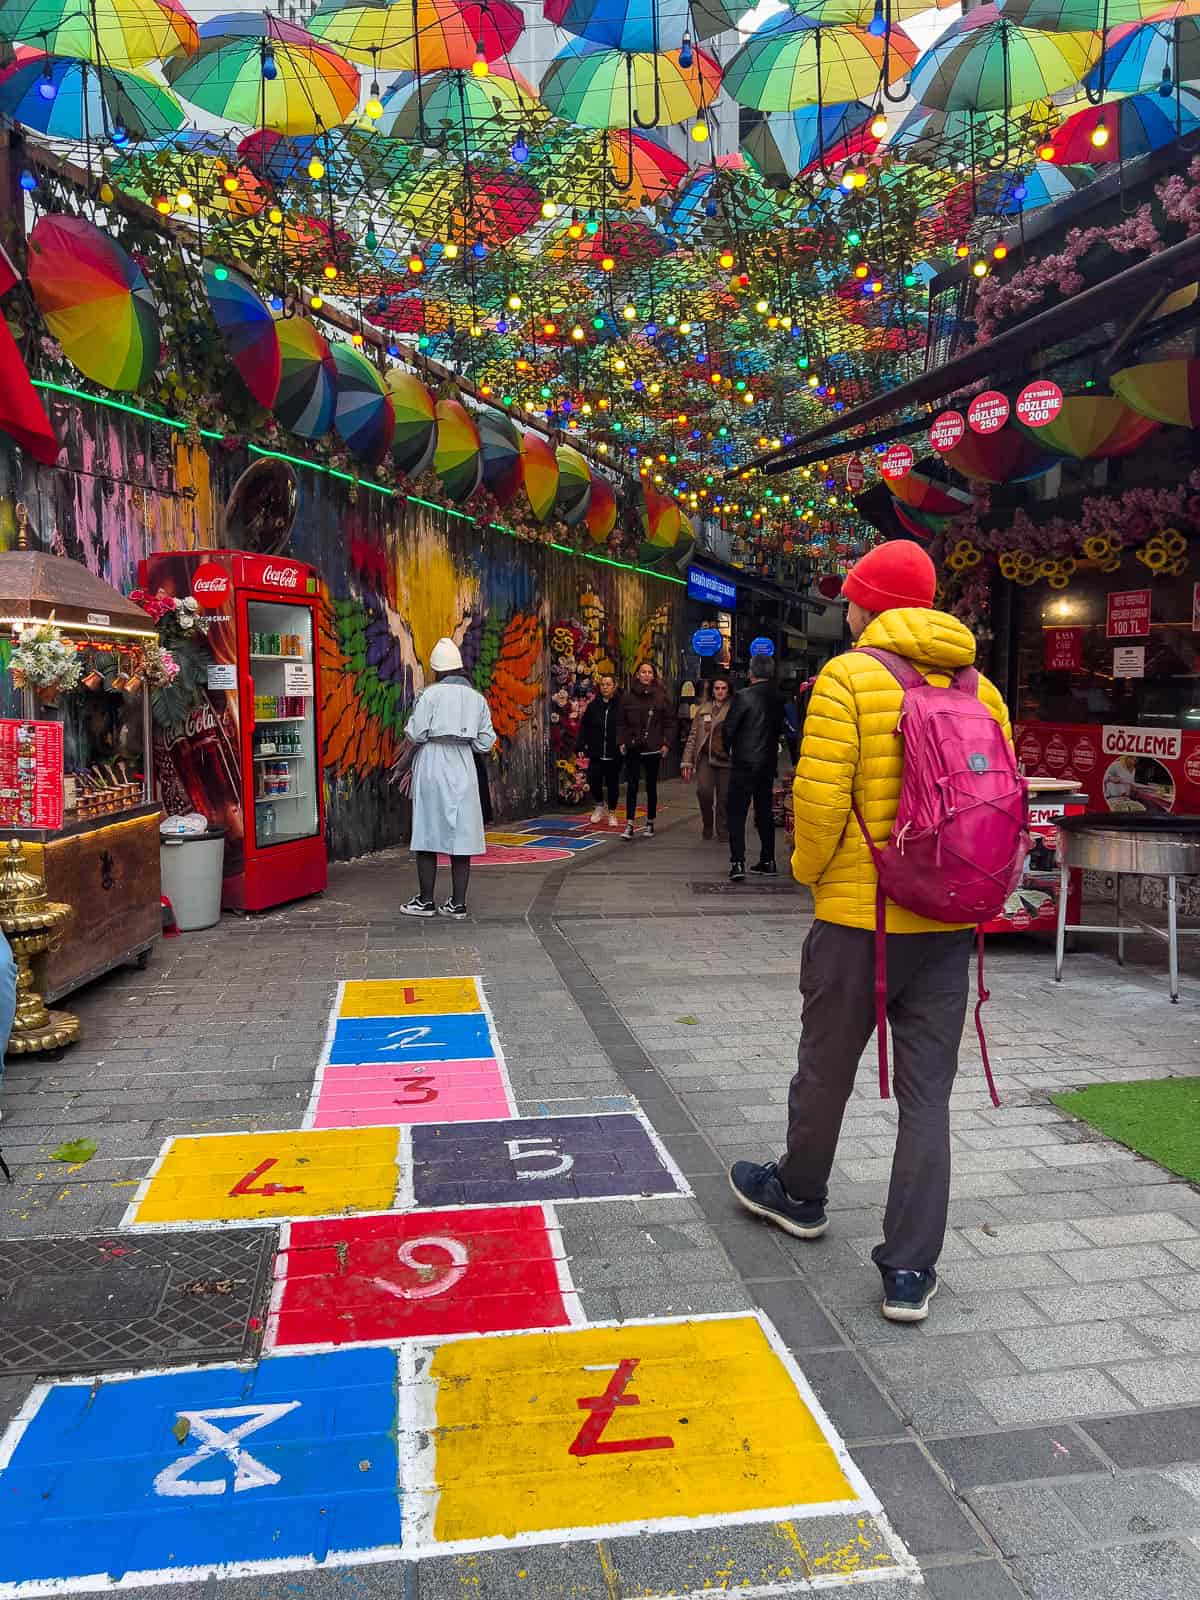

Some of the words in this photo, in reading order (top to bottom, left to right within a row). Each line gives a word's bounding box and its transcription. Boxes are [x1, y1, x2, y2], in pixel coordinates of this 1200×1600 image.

[1018, 398, 1060, 412] GÖZLEME
[969, 406, 1007, 423] GÖZLEME
[1028, 410, 1049, 422] 200
[980, 418, 998, 430] 250
[937, 436, 953, 447] 200
[193, 577, 228, 592] Coca-Cola
[262, 564, 299, 588] Coca-Cola
[1114, 621, 1128, 635] 100
[1130, 620, 1141, 633] TL
[1106, 730, 1177, 756] GÖZLEME
[377, 1025, 448, 1051] 2
[392, 1076, 439, 1105] 3
[504, 1137, 574, 1181] 5
[229, 1158, 304, 1196] 4
